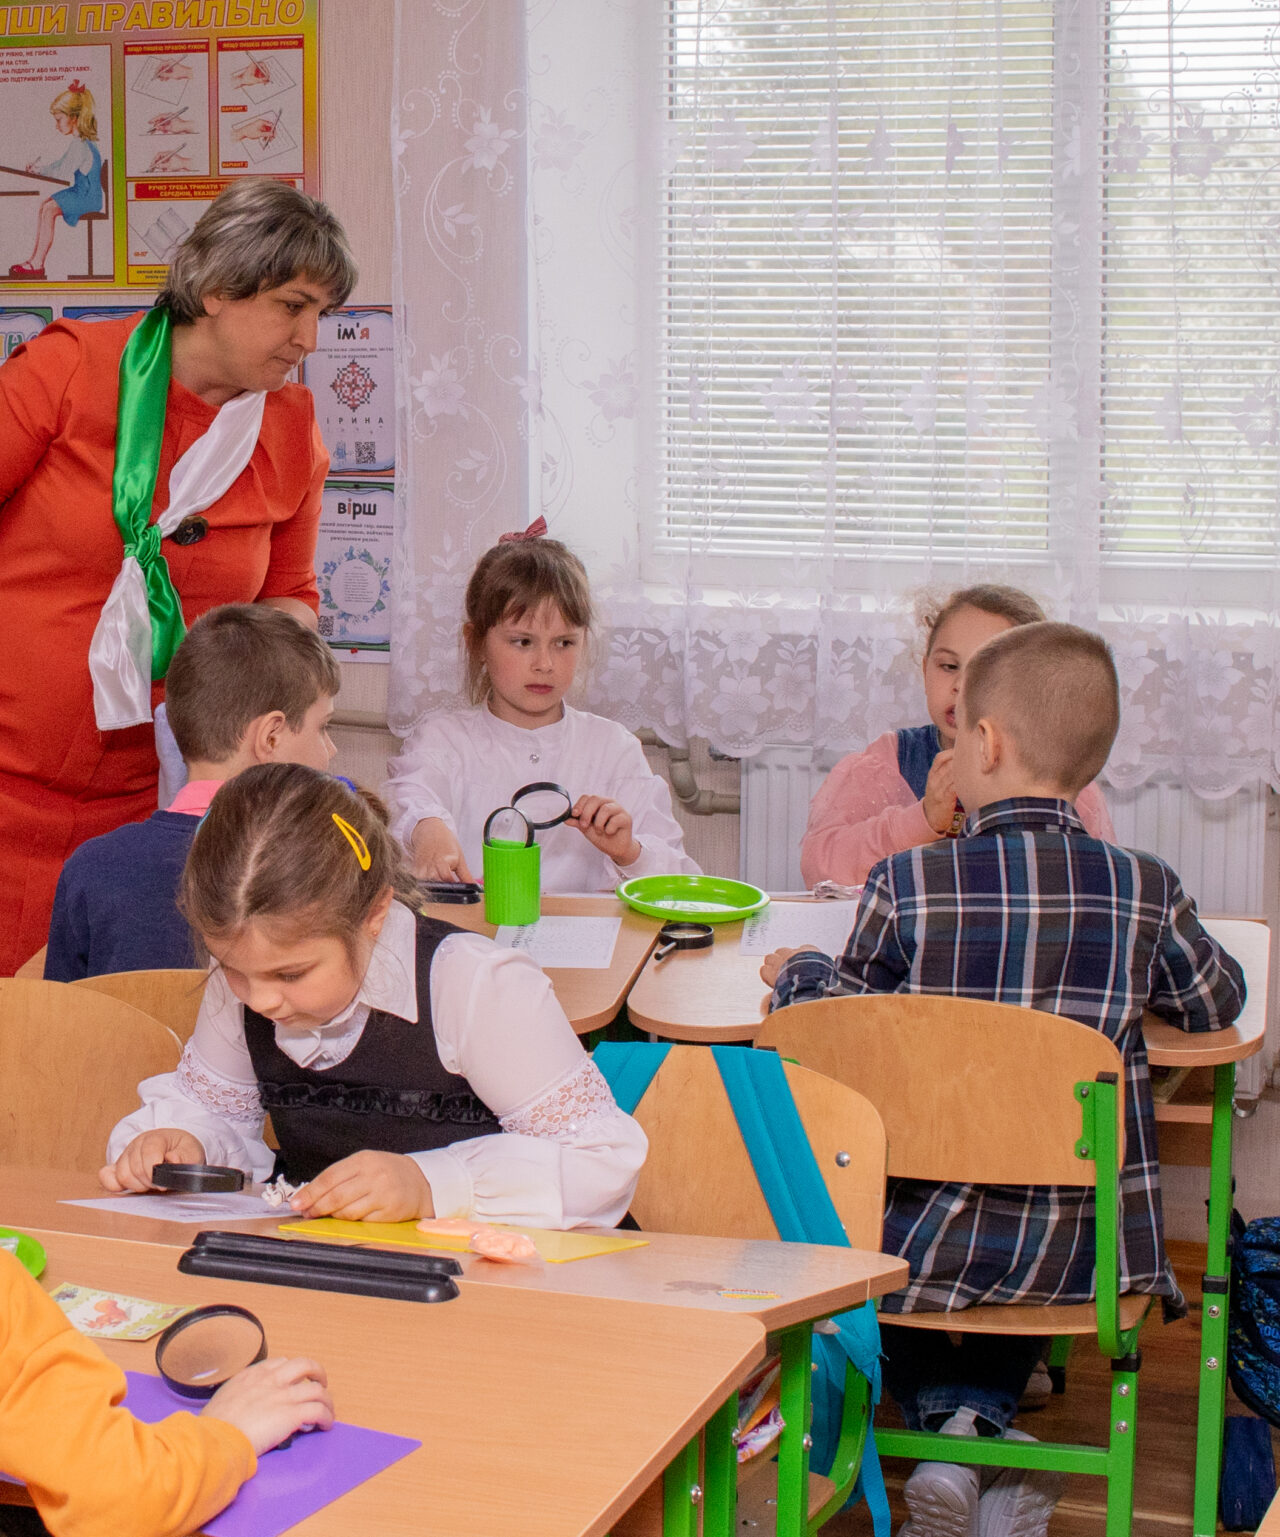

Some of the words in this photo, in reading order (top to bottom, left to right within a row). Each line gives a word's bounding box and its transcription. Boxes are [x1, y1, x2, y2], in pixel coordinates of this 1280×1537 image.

[76, 0, 306, 34] ПРАВИЛЬНО
[337, 323, 370, 340] ім'я
[338, 498, 377, 520] вірш
